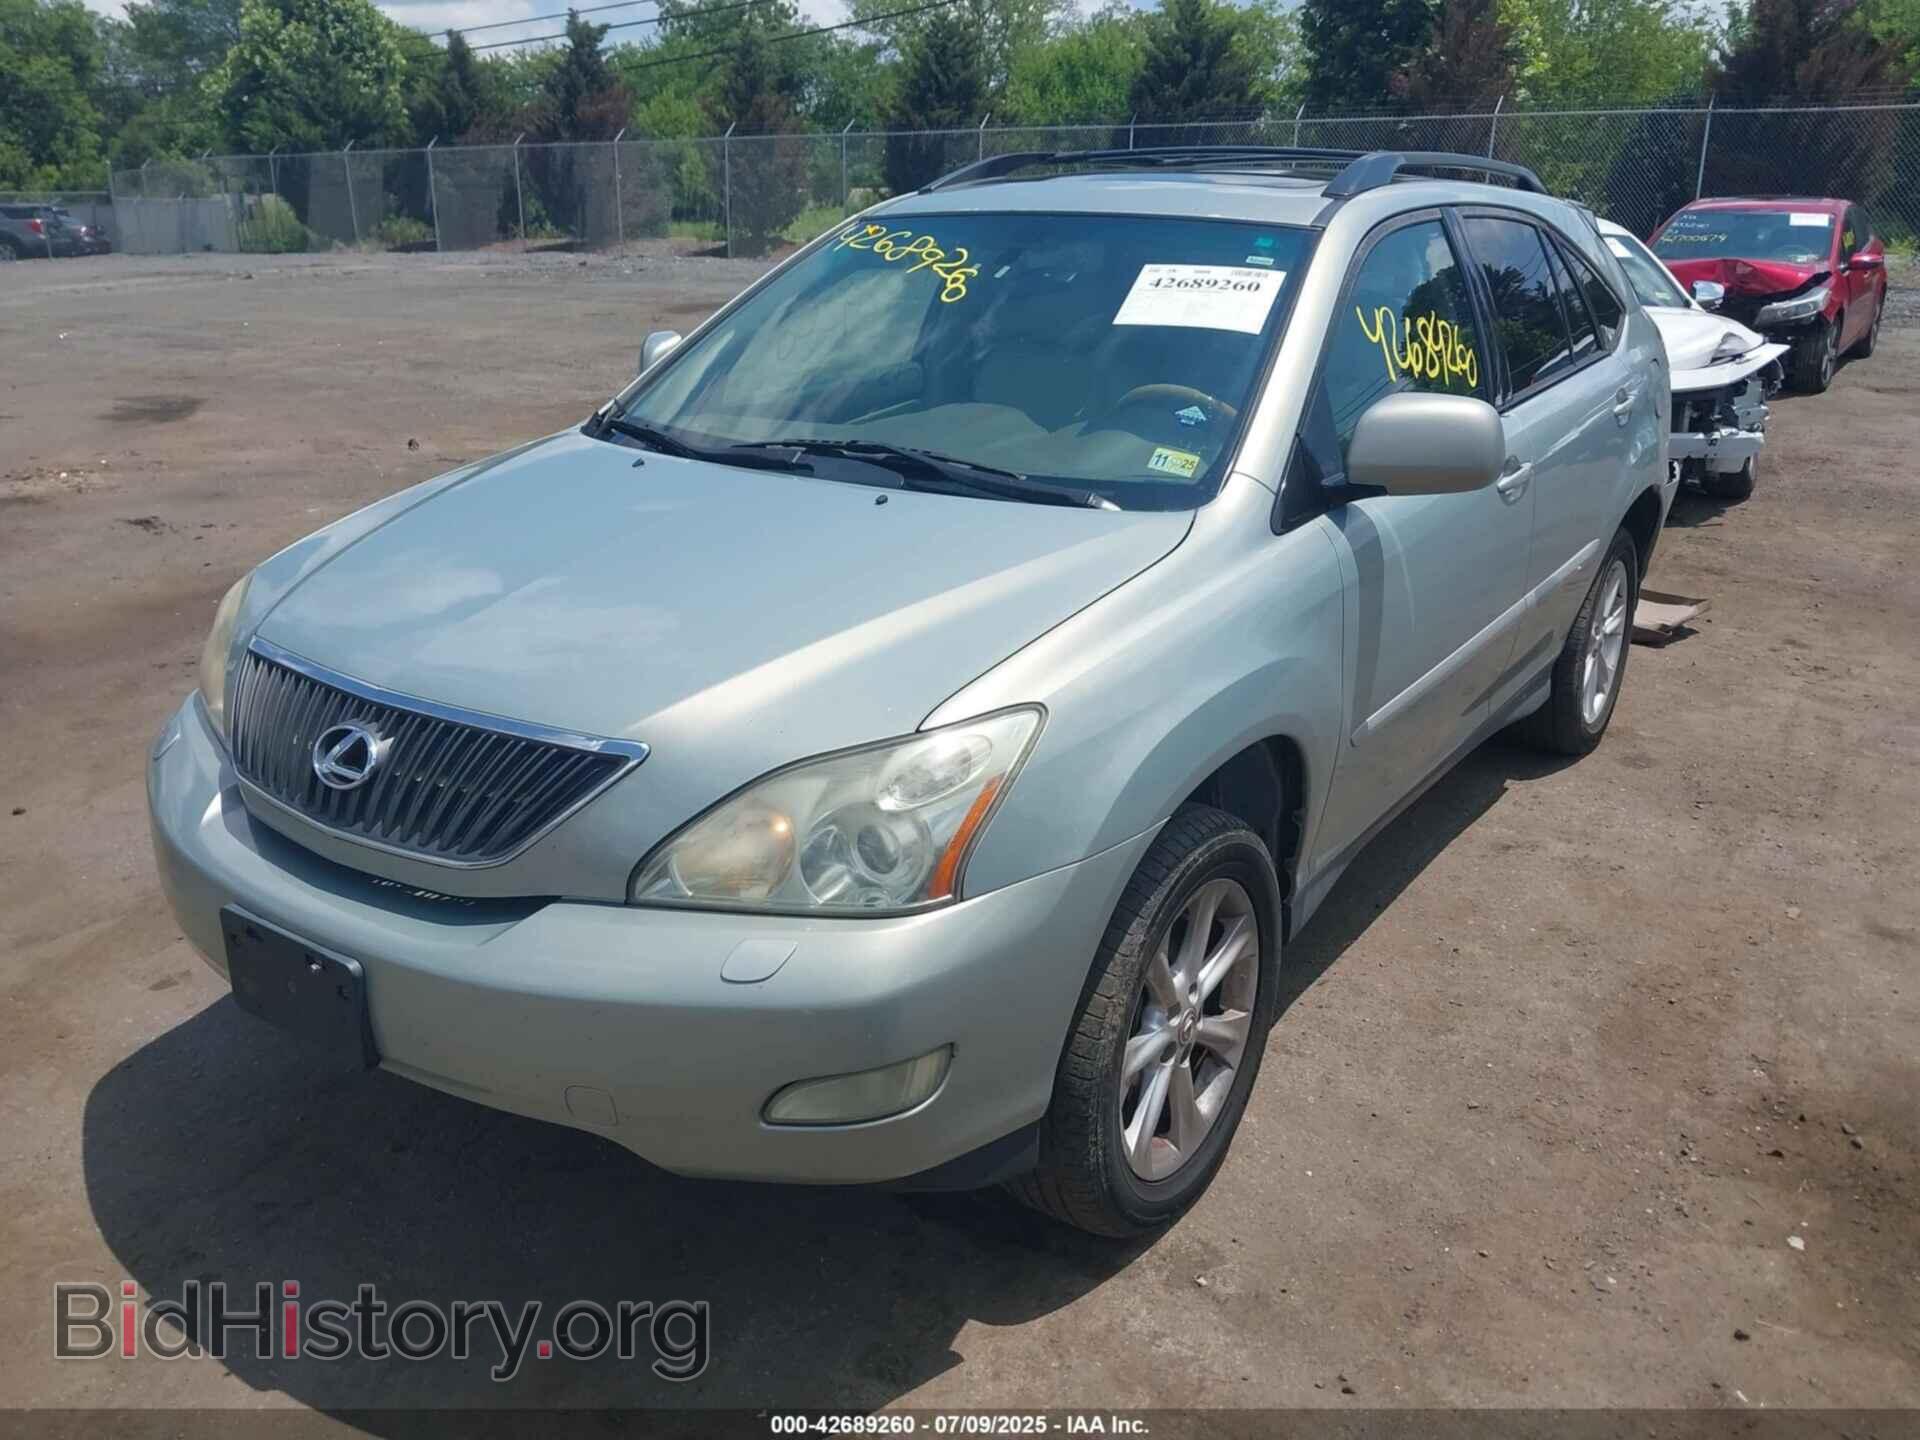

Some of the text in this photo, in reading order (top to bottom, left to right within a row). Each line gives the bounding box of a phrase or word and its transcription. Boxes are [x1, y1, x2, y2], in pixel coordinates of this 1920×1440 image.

[1148, 277, 1261, 292] 42689260
[1153, 454, 1196, 470] 11 25
